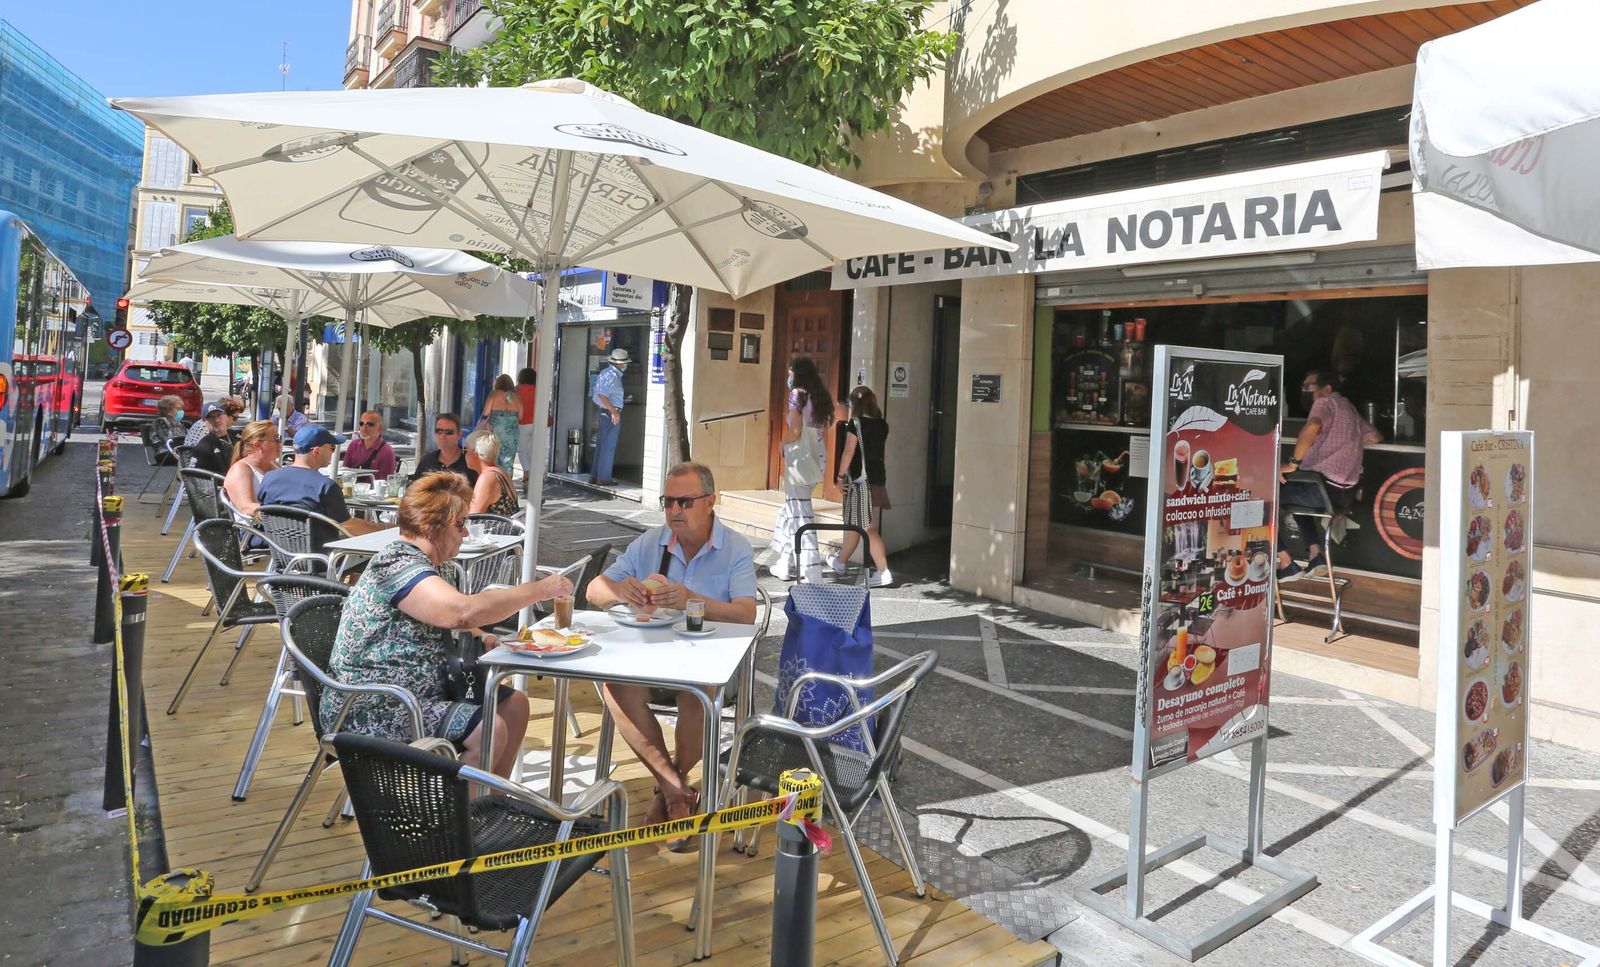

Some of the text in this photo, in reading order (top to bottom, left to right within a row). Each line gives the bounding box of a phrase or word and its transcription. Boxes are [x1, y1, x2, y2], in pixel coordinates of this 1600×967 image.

[944, 232, 1012, 270] BAR
[1034, 222, 1086, 261] LA
[1107, 189, 1342, 254] NOTARIA
[1170, 372, 1182, 392] La
[1224, 384, 1239, 406] La
[1246, 408, 1267, 416] CAFE BAR
[1166, 493, 1206, 508] sandwich
[1166, 508, 1197, 522] colacao
[1198, 510, 1204, 518] o
[1205, 504, 1231, 518] infusión
[1216, 587, 1236, 601] Café
[1244, 583, 1269, 596] Donut
[1200, 594, 1213, 612] 2€
[1157, 676, 1246, 712] Desayuno completo
[1157, 712, 1174, 725] Zumo
[1174, 708, 1184, 718] de
[1184, 702, 1207, 715] naranja
[1208, 695, 1228, 709] natural
[1162, 720, 1184, 733] tostada
[720, 804, 776, 824] SEGURIDAD
[483, 819, 694, 868] MANTEN LA DISTANCIA DE SEGURIDAD
[158, 898, 259, 928] SEGURIDAD
